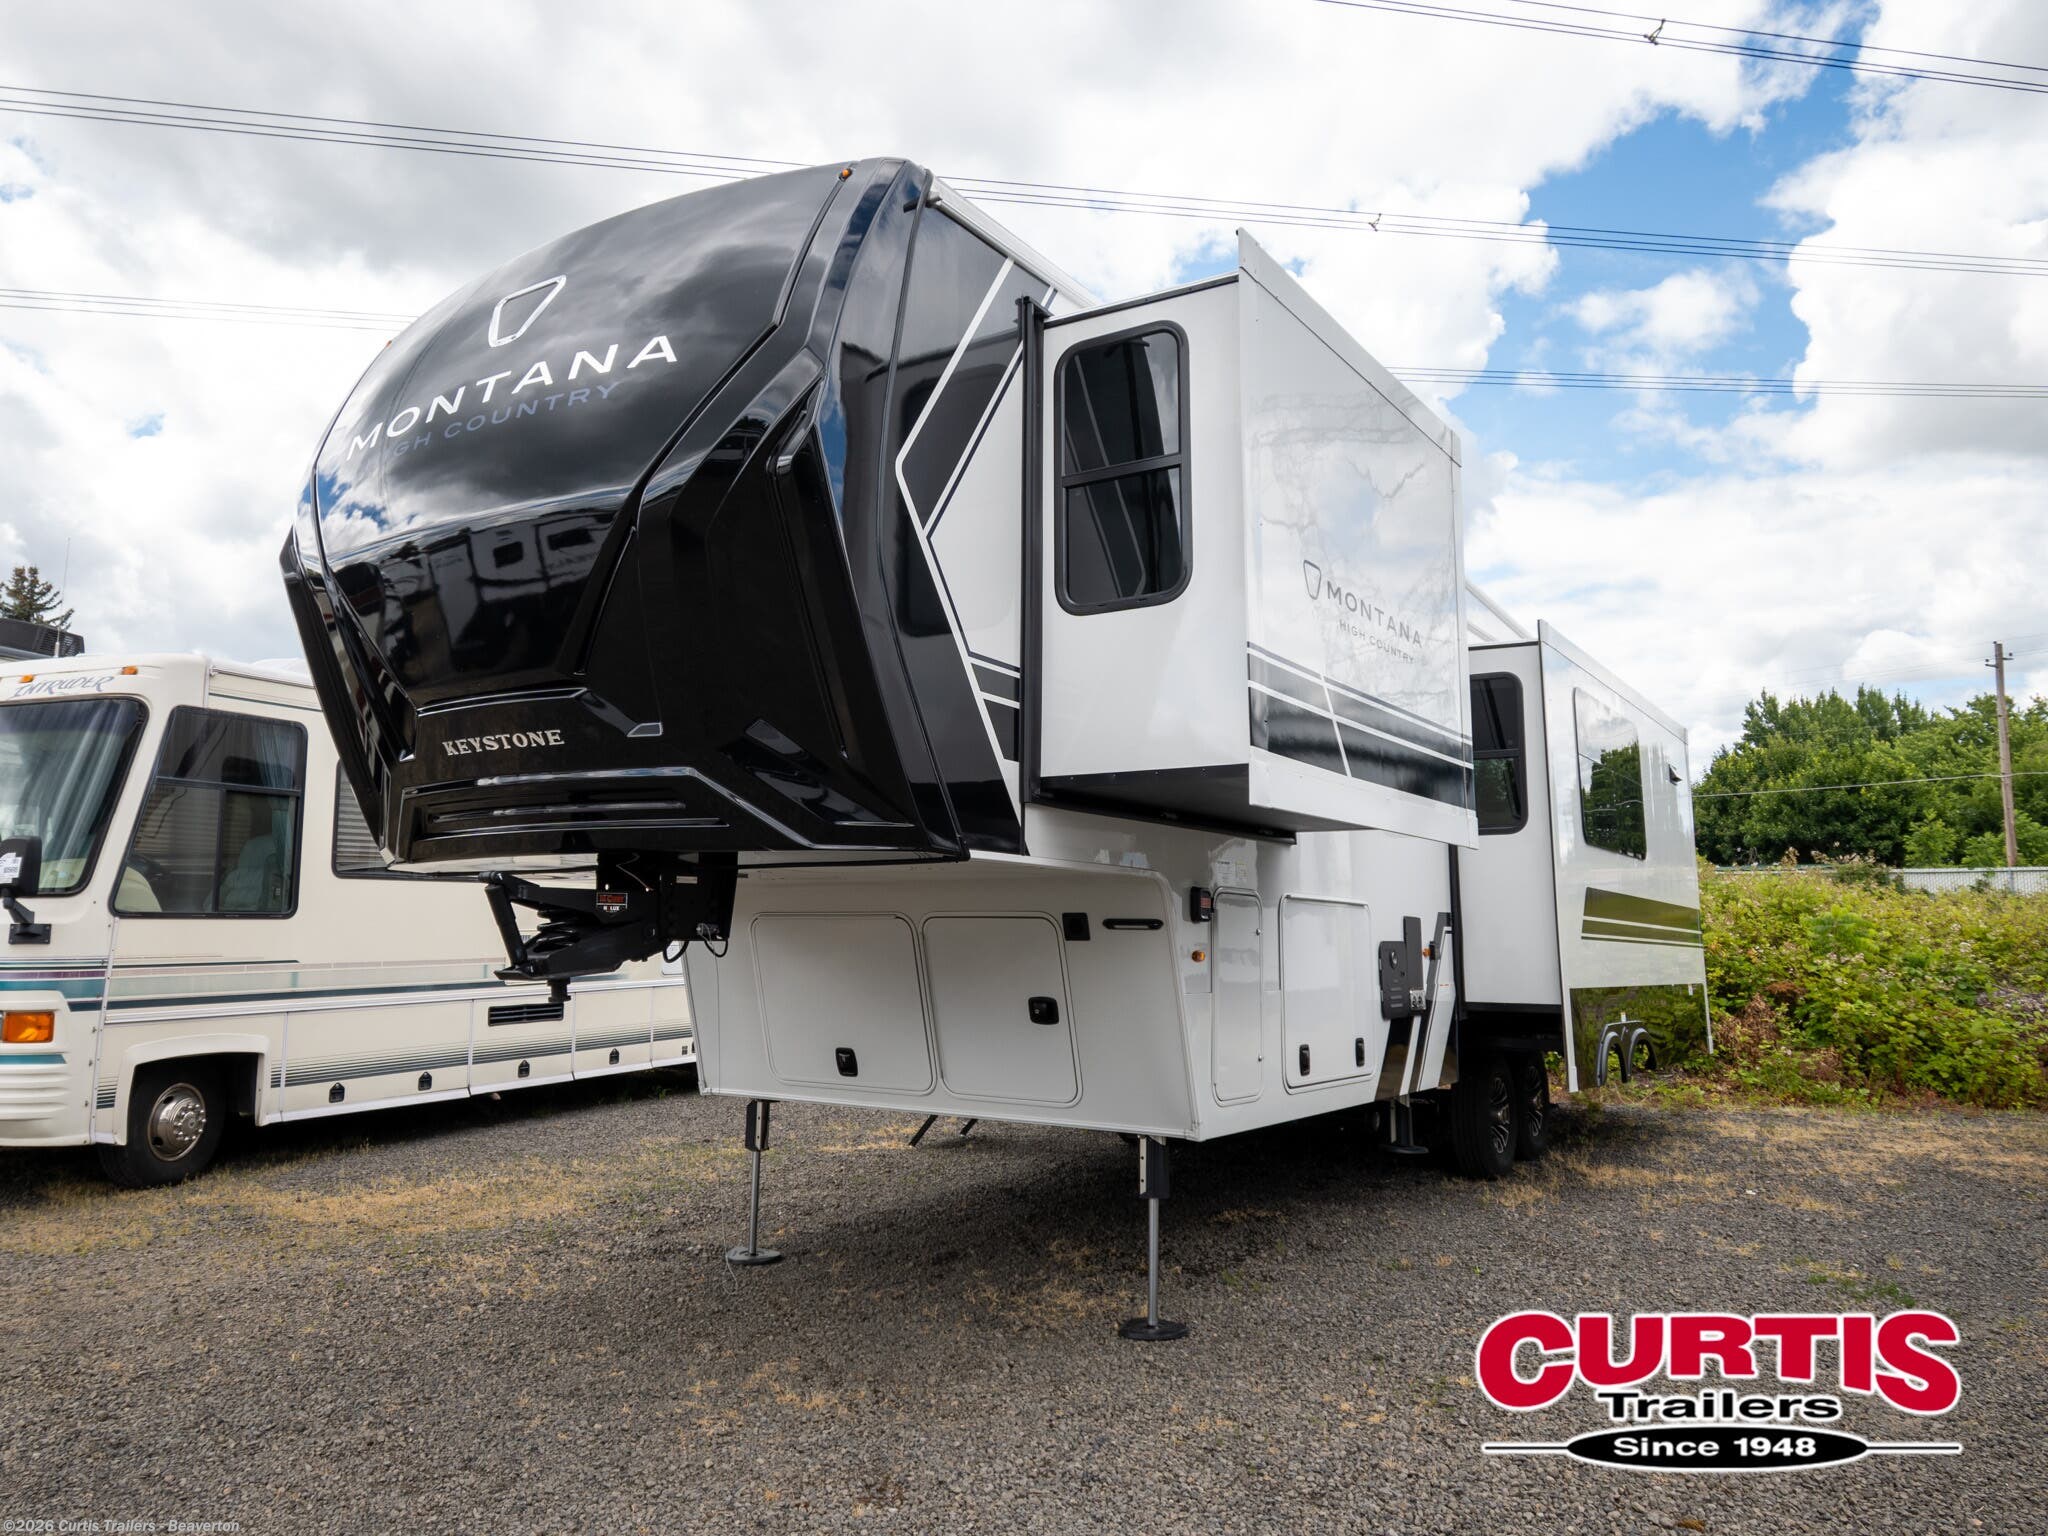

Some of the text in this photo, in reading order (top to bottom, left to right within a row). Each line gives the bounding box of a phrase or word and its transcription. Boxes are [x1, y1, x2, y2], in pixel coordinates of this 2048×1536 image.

[346, 335, 678, 461] MONTANA
[444, 382, 624, 439] COUNTRY
[1327, 580, 1422, 648] MONTANA
[1339, 619, 1414, 664] HIGH COUNTRY
[11, 676, 115, 698] INTRUDER
[442, 729, 565, 756] KEYSTONE
